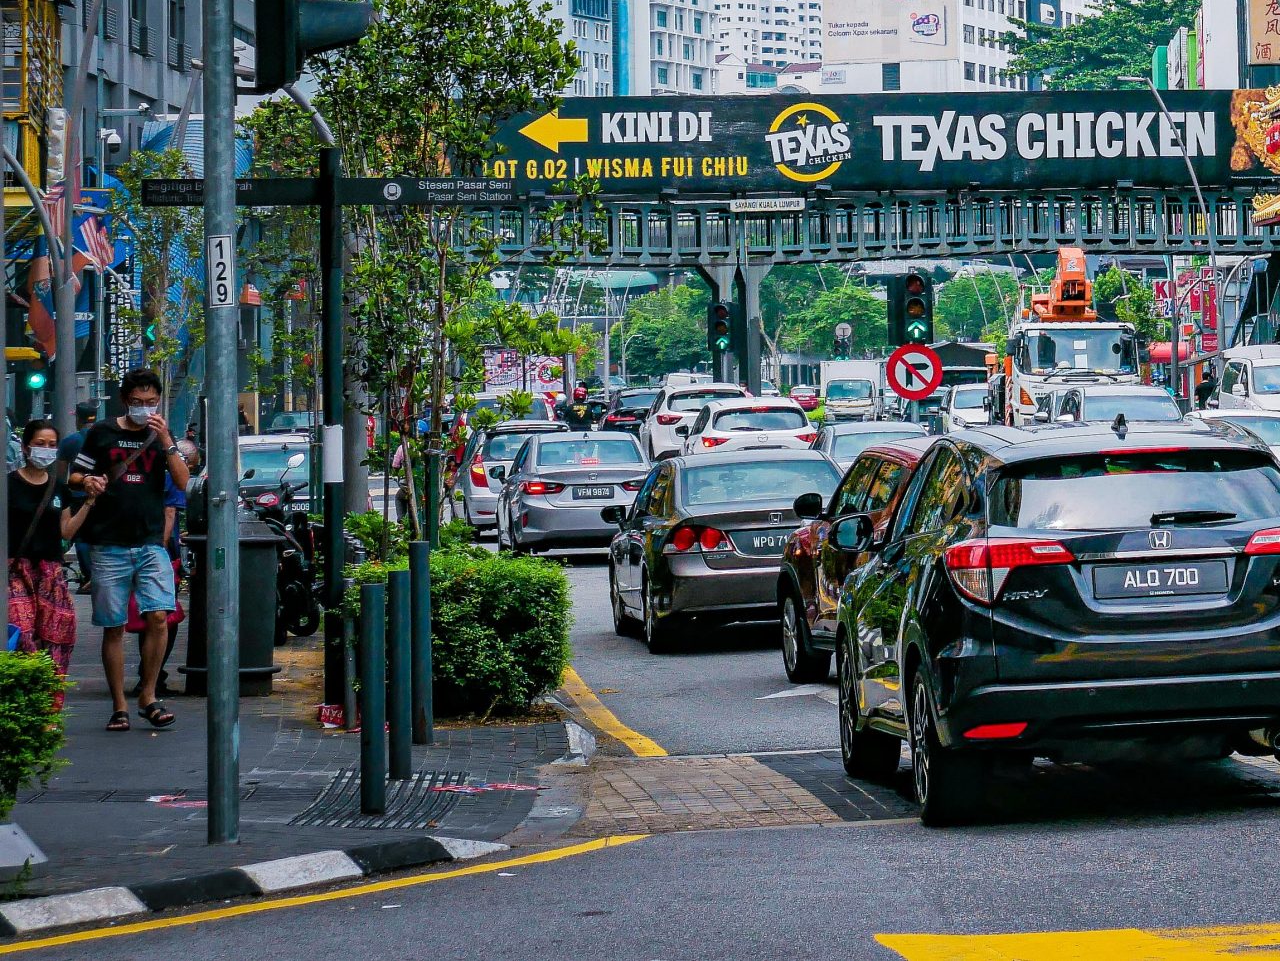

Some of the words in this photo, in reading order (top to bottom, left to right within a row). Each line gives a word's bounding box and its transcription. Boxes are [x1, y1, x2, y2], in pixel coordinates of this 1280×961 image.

[602, 111, 673, 144] KINI
[678, 111, 713, 143] DI
[764, 122, 851, 167] TEXAS
[873, 110, 1008, 172] TEXAS
[1016, 111, 1216, 160] CHICKEN
[526, 158, 568, 180] G.02
[586, 157, 653, 179] WISMA
[661, 157, 693, 177] FUI
[701, 156, 748, 177] CHIU
[808, 152, 852, 166] CHICKEN
[418, 180, 454, 190] Stesen
[457, 180, 487, 190] Pasar
[488, 180, 512, 190] Seni
[427, 192, 454, 201] Pasar
[456, 191, 477, 201] Seni
[479, 192, 512, 201] Station
[213, 239, 229, 303] 129
[753, 535, 775, 548] WPQ
[1123, 568, 1160, 590] ALQ
[1166, 567, 1199, 586] 700
